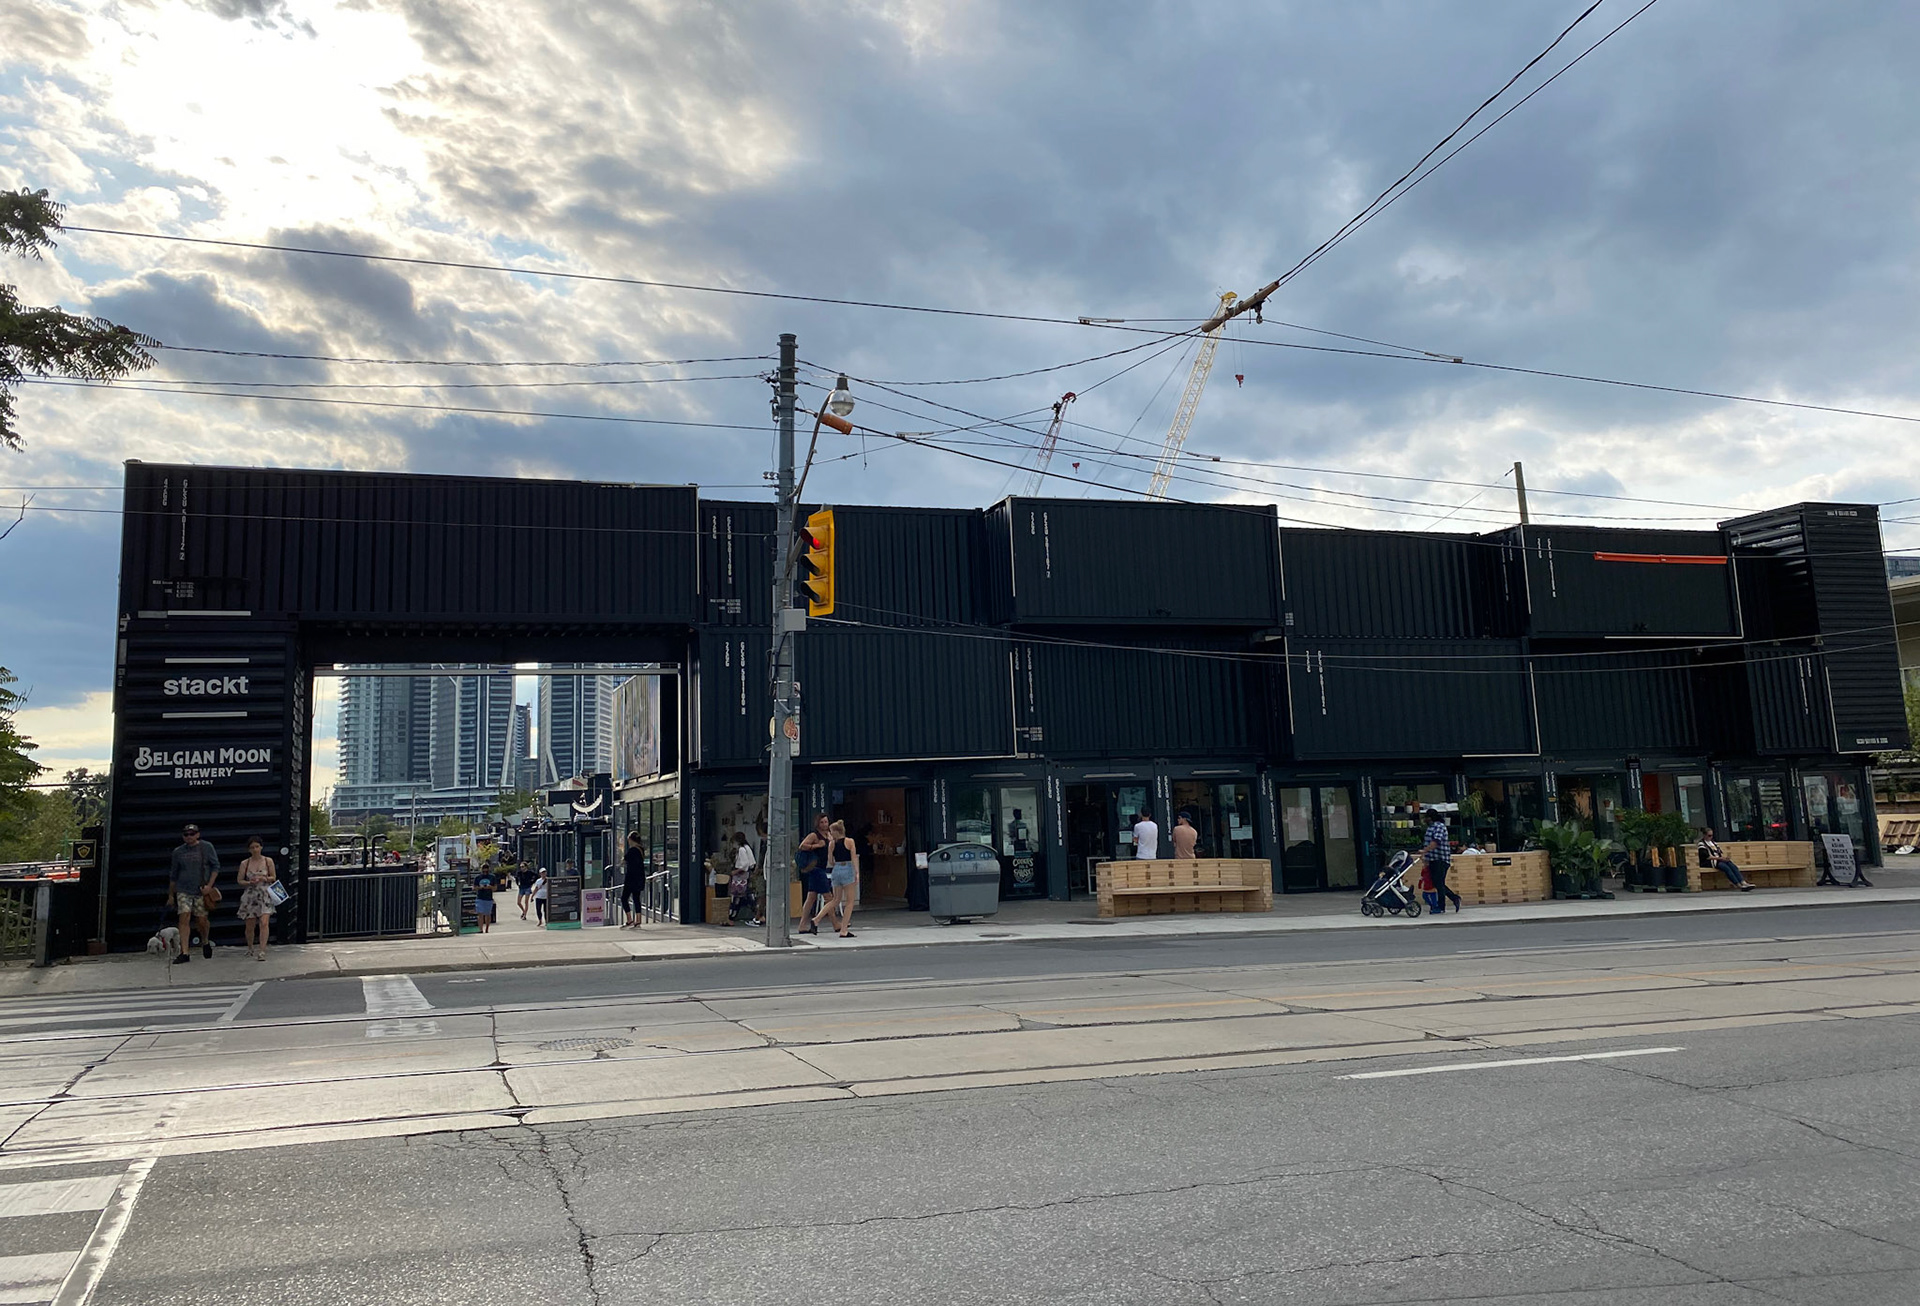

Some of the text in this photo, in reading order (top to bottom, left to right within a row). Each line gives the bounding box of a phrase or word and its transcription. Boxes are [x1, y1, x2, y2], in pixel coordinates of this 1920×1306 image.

[163, 676, 249, 696] stackt
[134, 746, 271, 771] BELGIAN MOON
[174, 767, 234, 779] BREWERY
